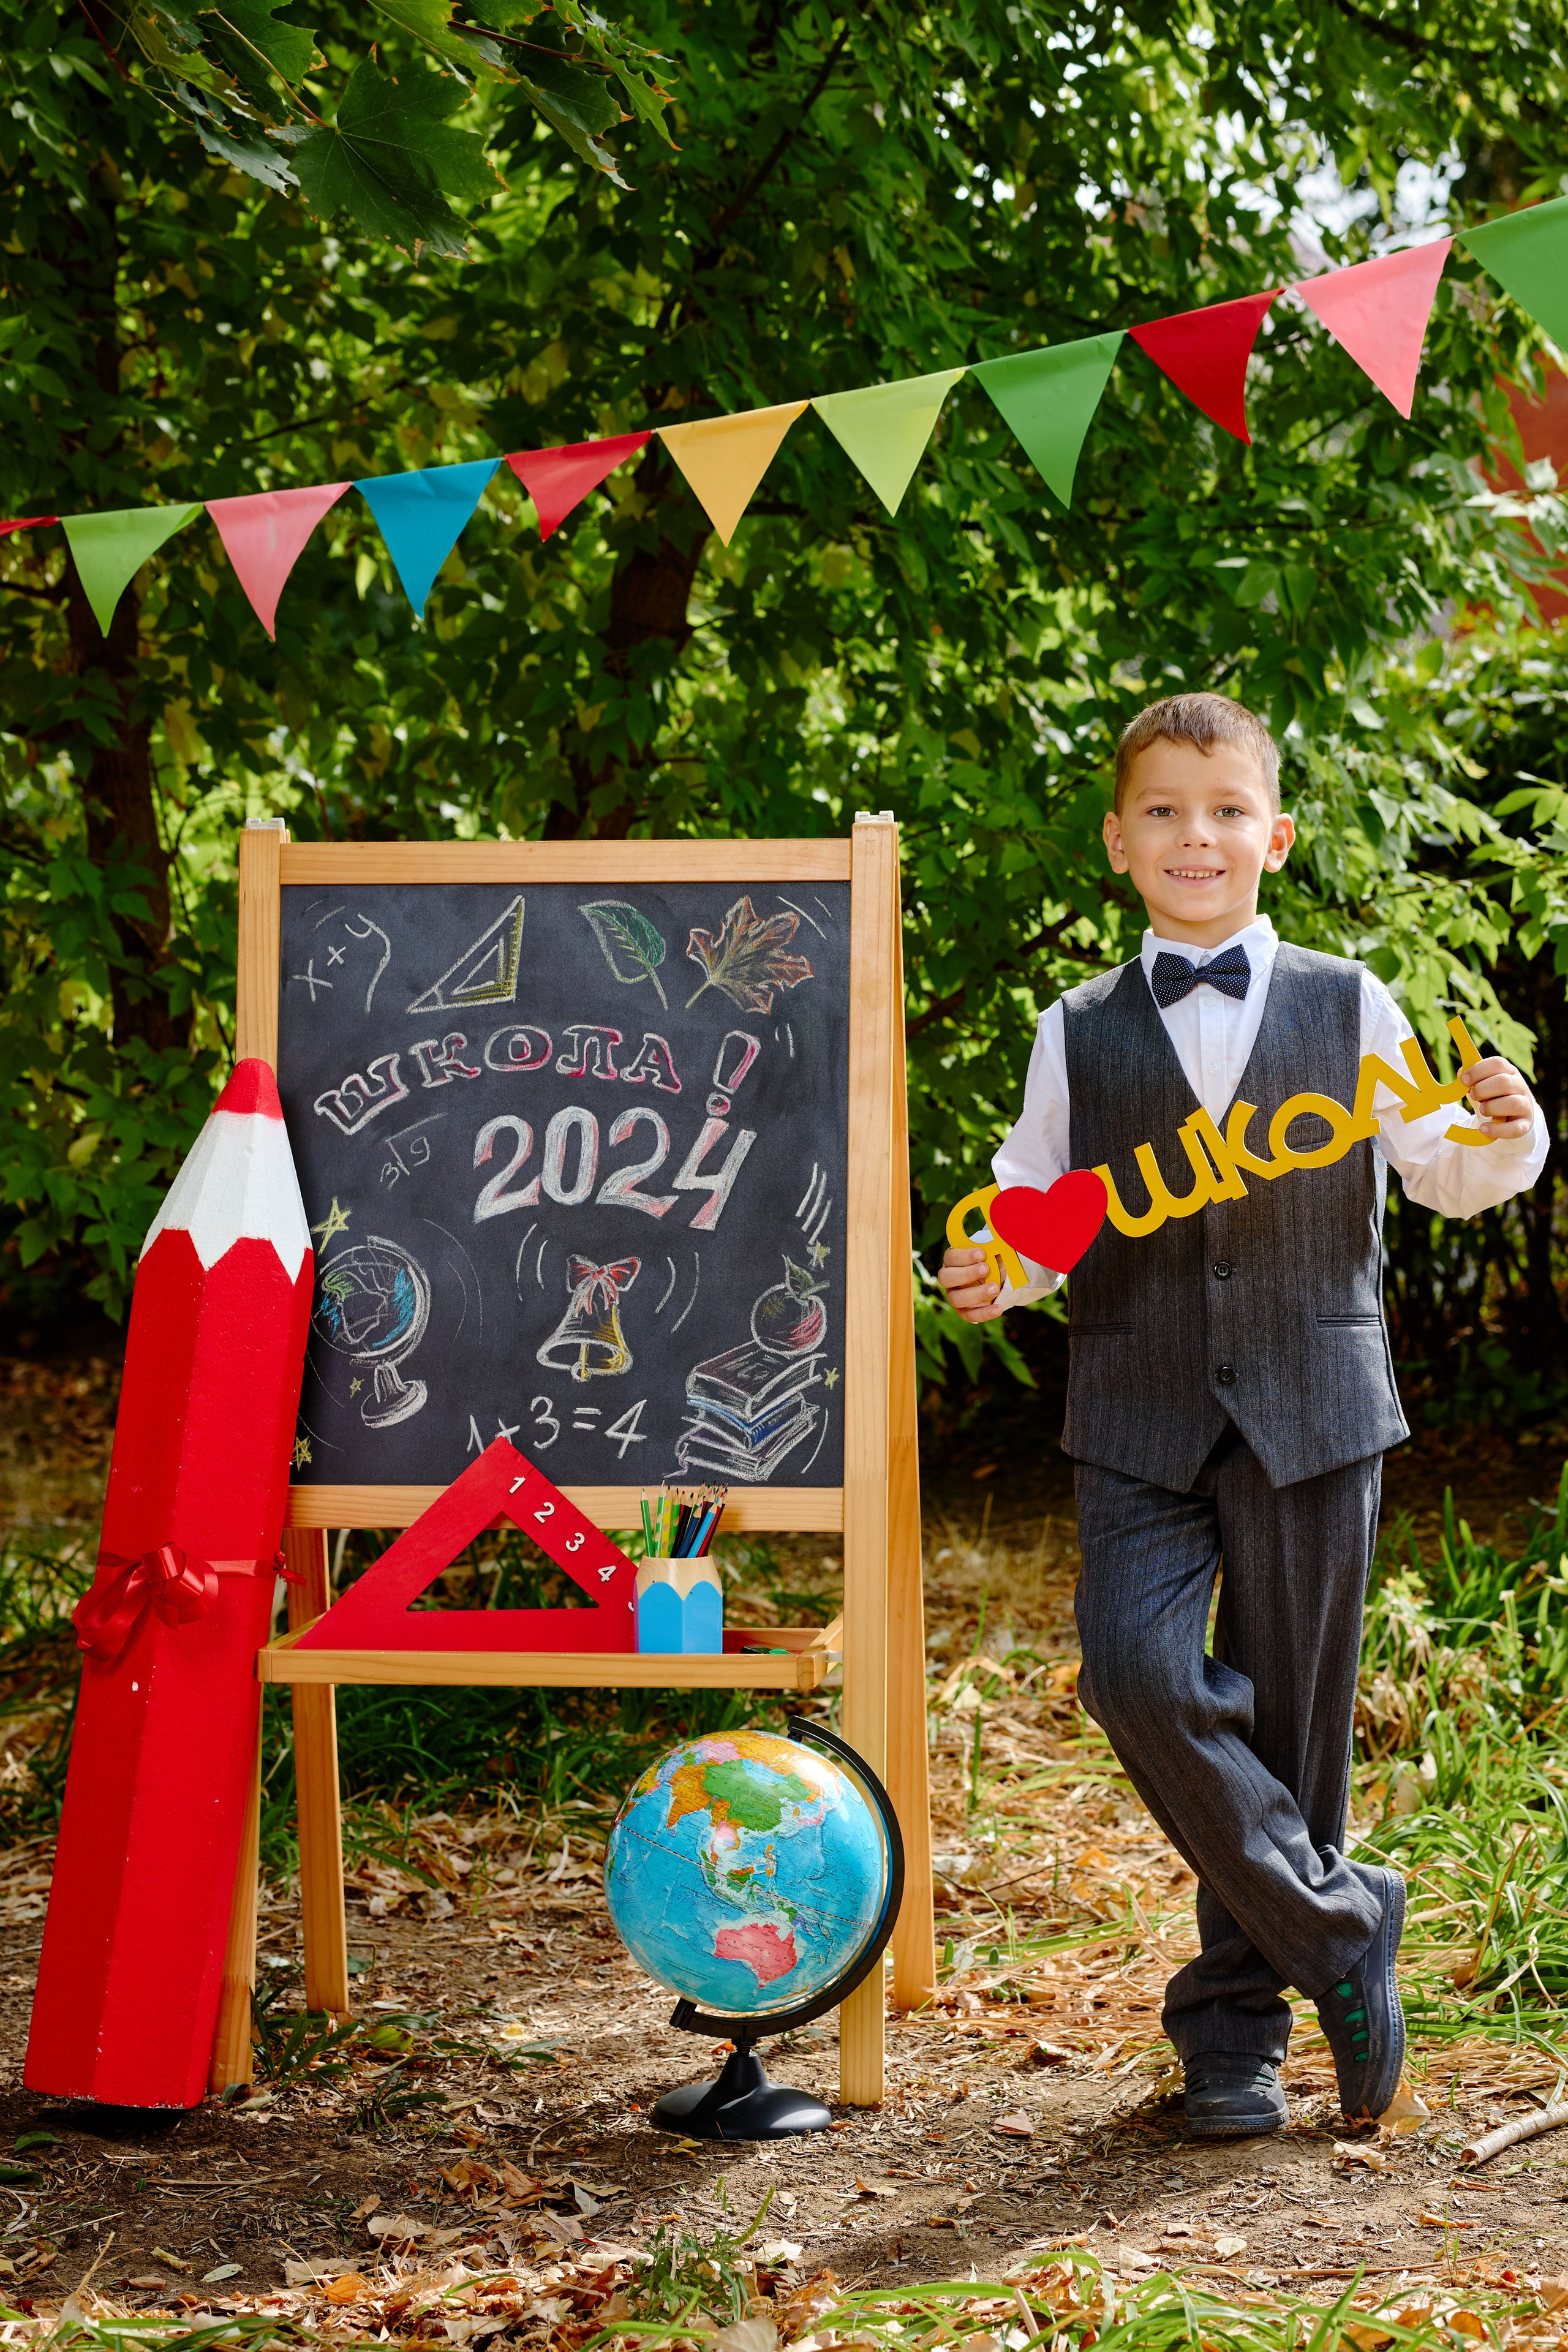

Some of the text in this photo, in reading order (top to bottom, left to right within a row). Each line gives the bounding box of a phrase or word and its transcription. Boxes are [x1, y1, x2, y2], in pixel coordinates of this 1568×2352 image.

[473, 1106, 758, 1231] 2024
[509, 1476, 617, 1582] 1 2 3 4
